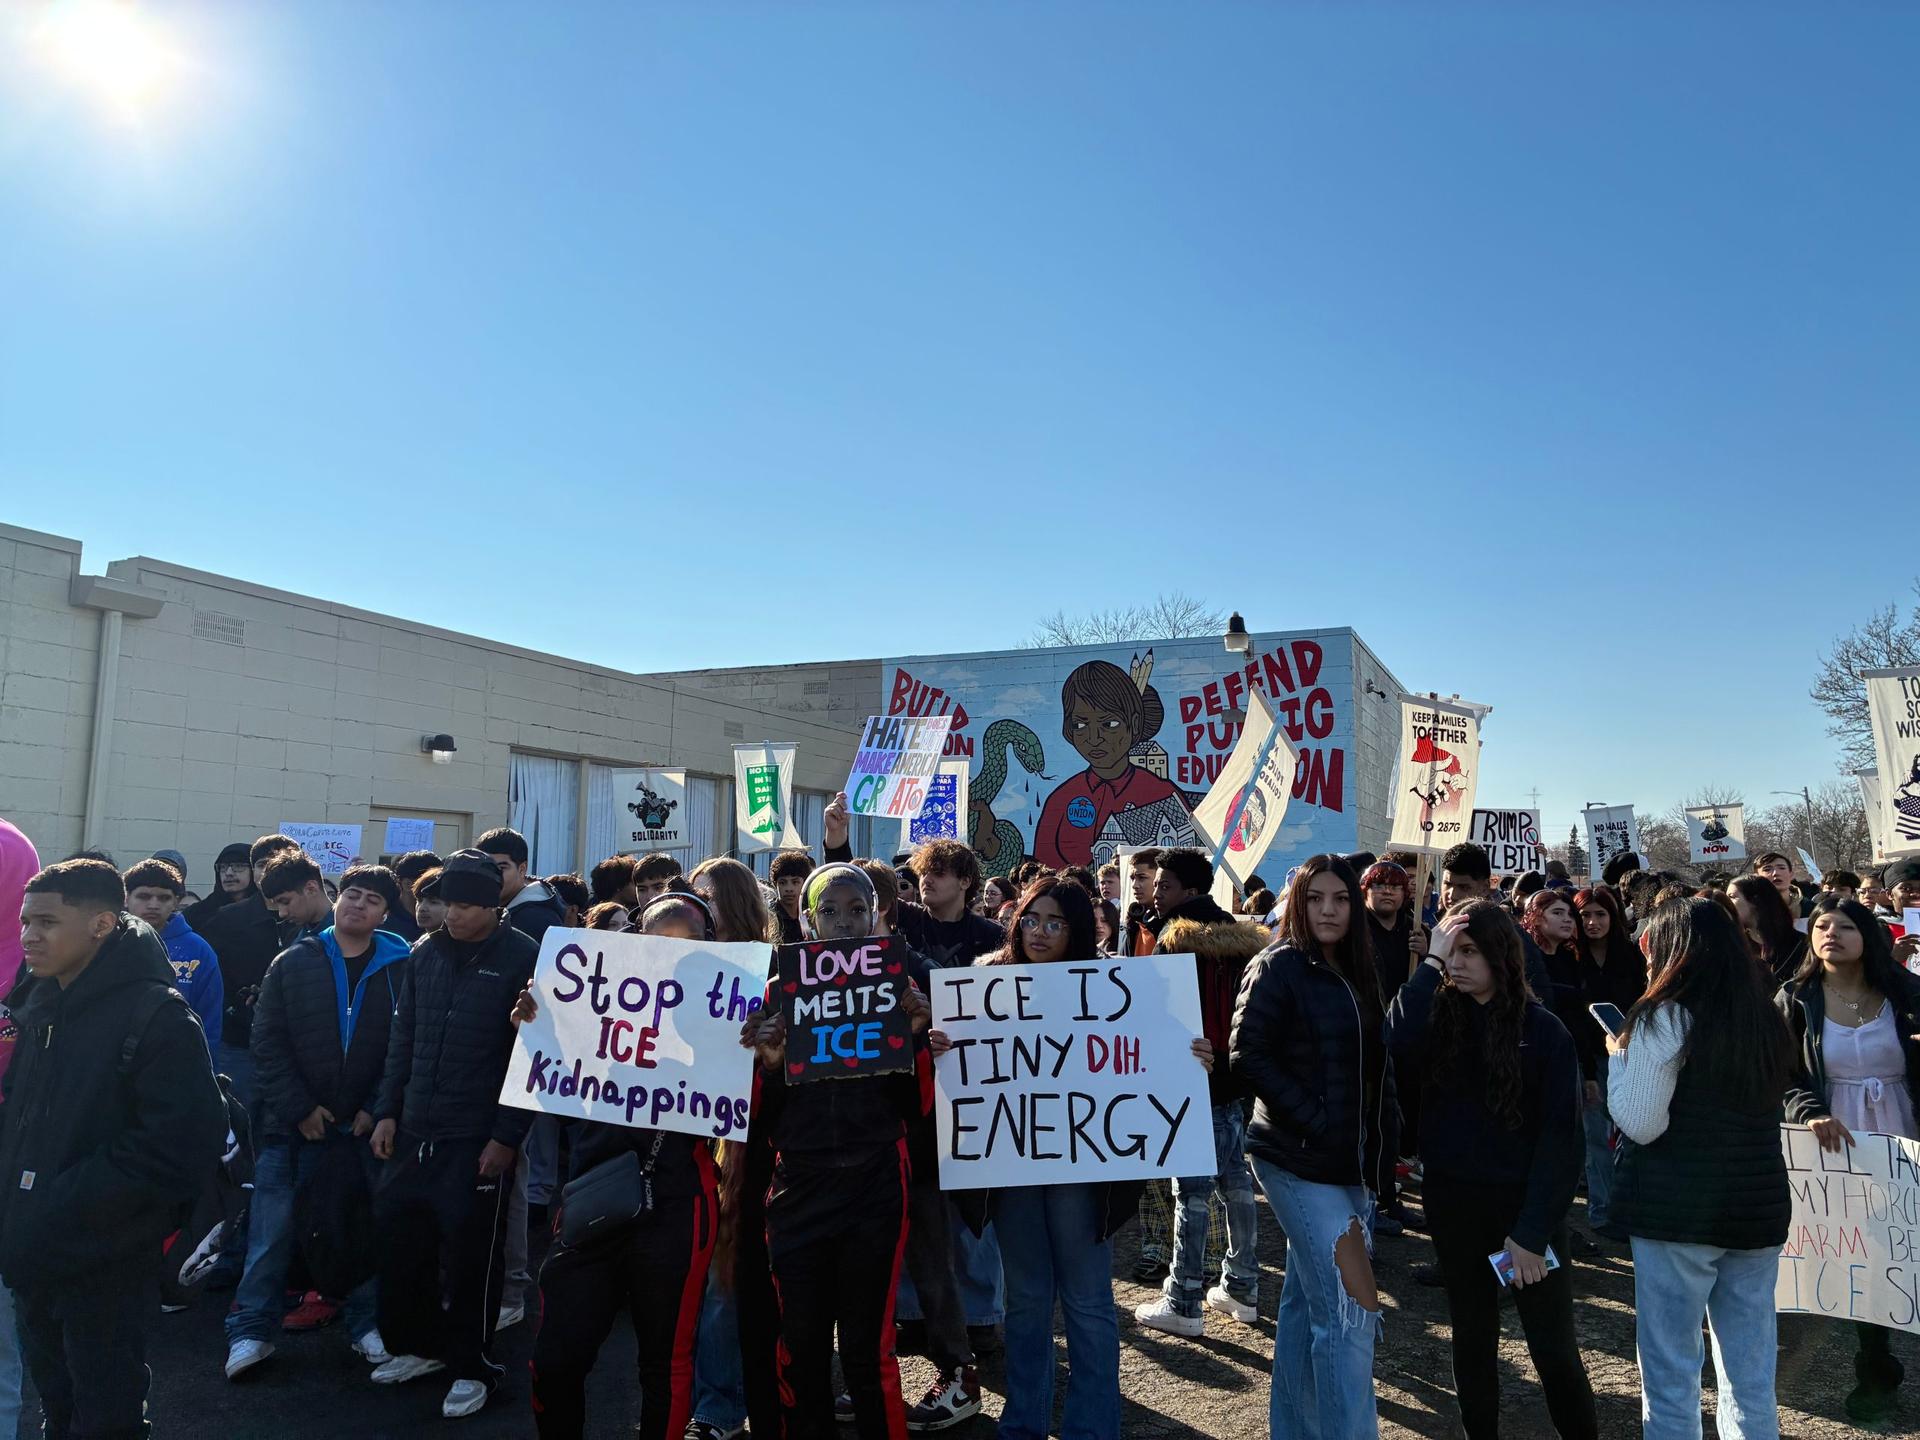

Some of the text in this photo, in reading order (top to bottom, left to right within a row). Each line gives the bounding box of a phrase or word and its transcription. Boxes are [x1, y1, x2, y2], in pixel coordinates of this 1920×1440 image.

[1180, 640, 1322, 724] DEFEND
[866, 717, 928, 750] HATE
[1187, 688, 1334, 753] PUIC
[1412, 711, 1431, 724] KEEP
[1413, 725, 1467, 744] TOGETHER
[852, 751, 938, 776] MAKE AMERICA
[1177, 748, 1344, 813] EDUON
[852, 775, 919, 816] GRAT
[1068, 808, 1094, 819] UNION
[632, 830, 678, 841] SOLIDARITY
[1420, 821, 1460, 833] NO 287G
[1470, 809, 1532, 842] TRUMP
[1594, 821, 1628, 833] NO WALLS
[1703, 845, 1729, 854] NOW
[799, 945, 882, 985] LOVE
[553, 943, 762, 1029] Stop the
[942, 966, 1131, 1022] ICE IS
[596, 1017, 659, 1069] ICE
[810, 1022, 883, 1064] ICE
[951, 1033, 1073, 1086] TINY
[651, 1130, 666, 1157] KOR
[951, 1092, 1190, 1167] ENERGY
[1788, 1176, 1920, 1226] MY HORC
[1783, 1224, 1868, 1259] WARM
[1778, 1256, 1866, 1319] ICE
